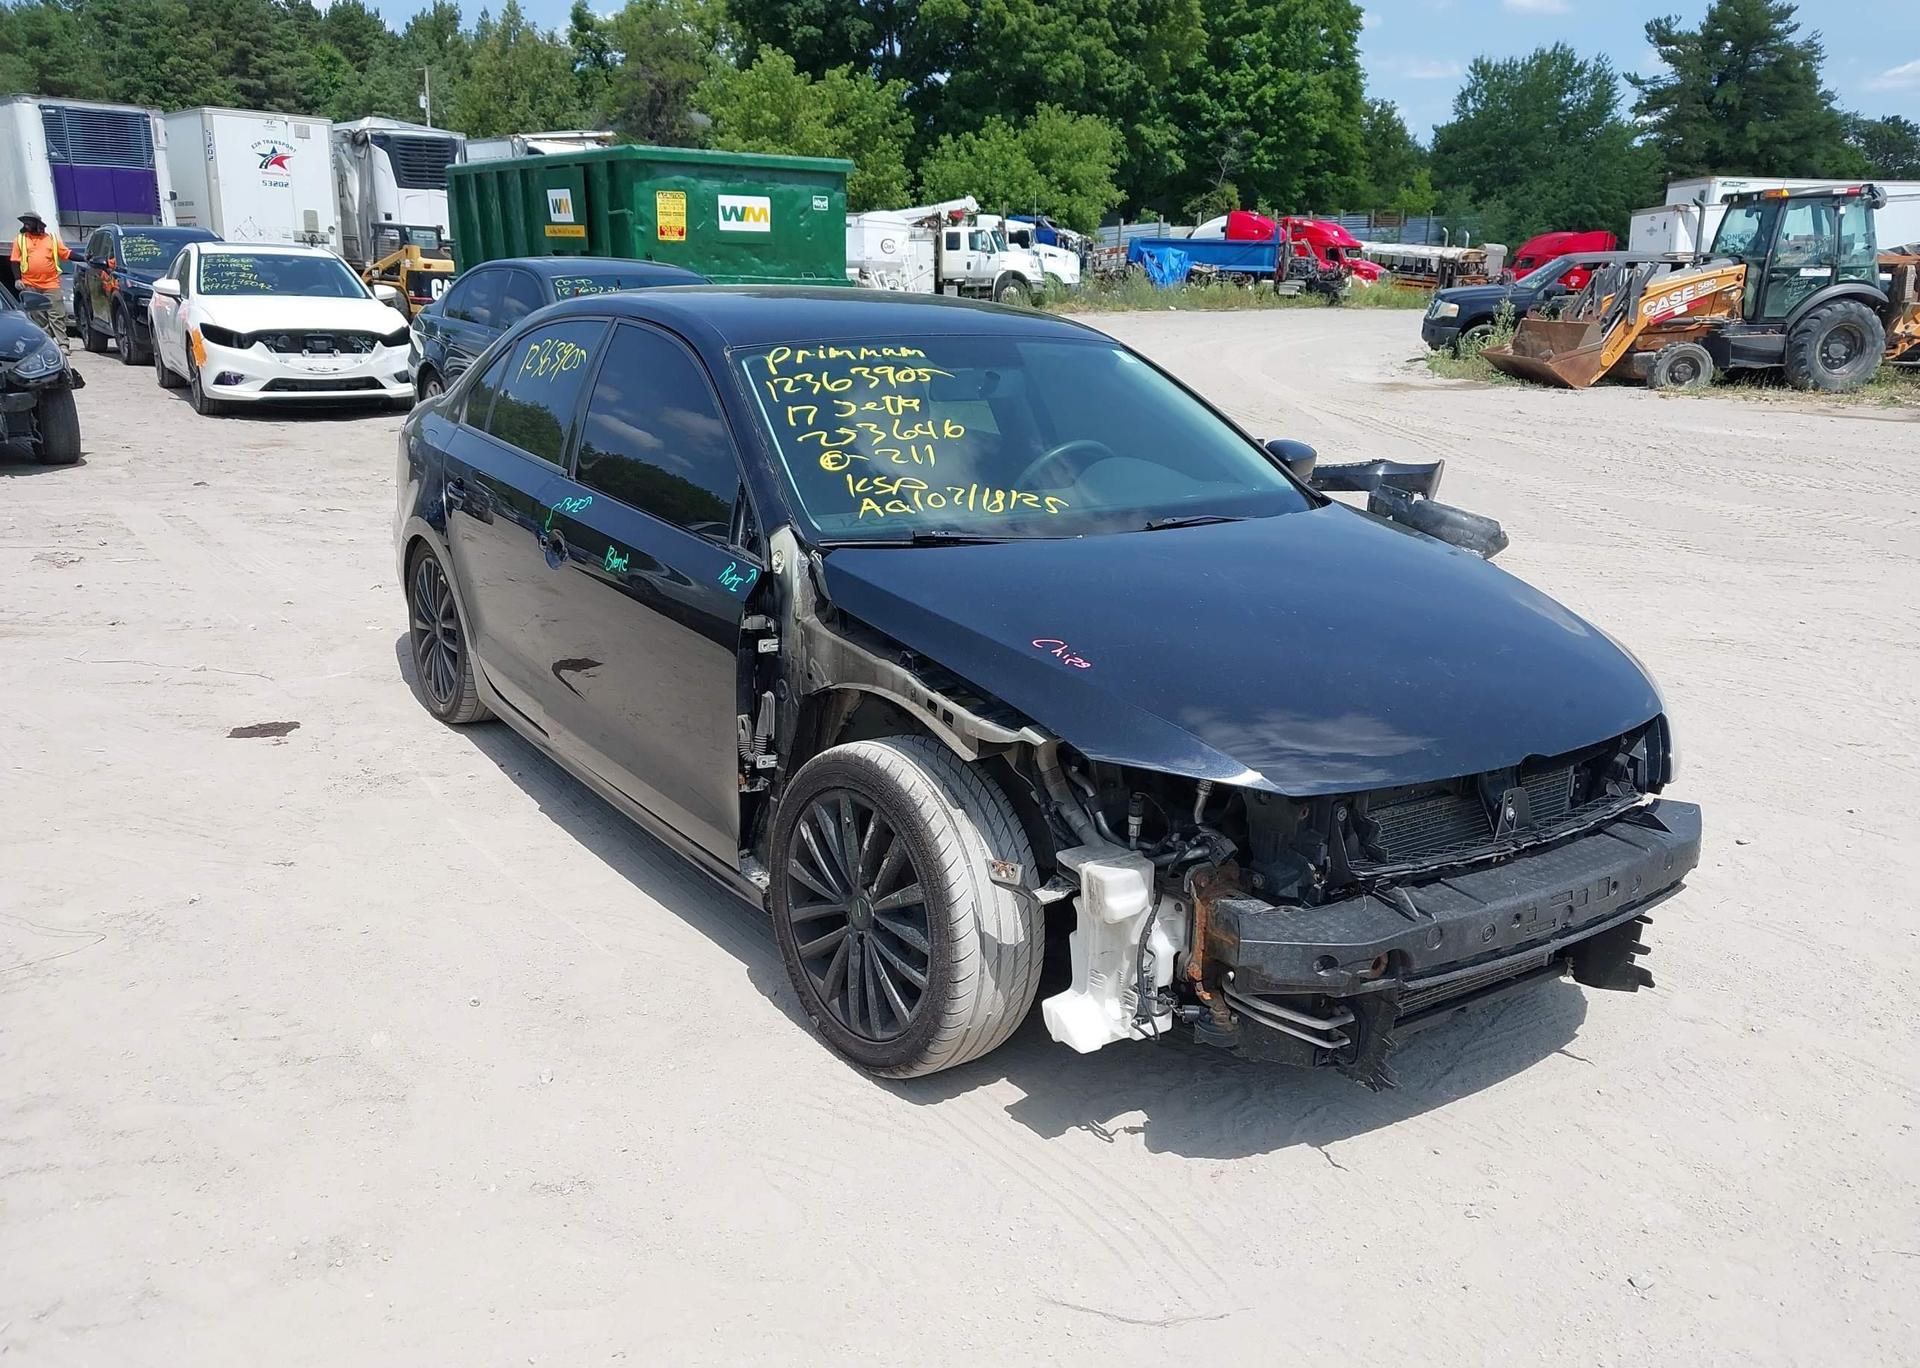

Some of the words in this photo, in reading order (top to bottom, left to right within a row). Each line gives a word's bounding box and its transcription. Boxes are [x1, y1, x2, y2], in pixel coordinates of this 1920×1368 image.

[262, 179, 289, 188] 53202
[550, 198, 571, 214] WM
[720, 205, 769, 223] WM
[431, 278, 454, 301] CA
[1642, 285, 1695, 316] CASE
[1697, 278, 1717, 291] 580
[787, 405, 819, 427] 17
[1032, 639, 1091, 668] Chips
